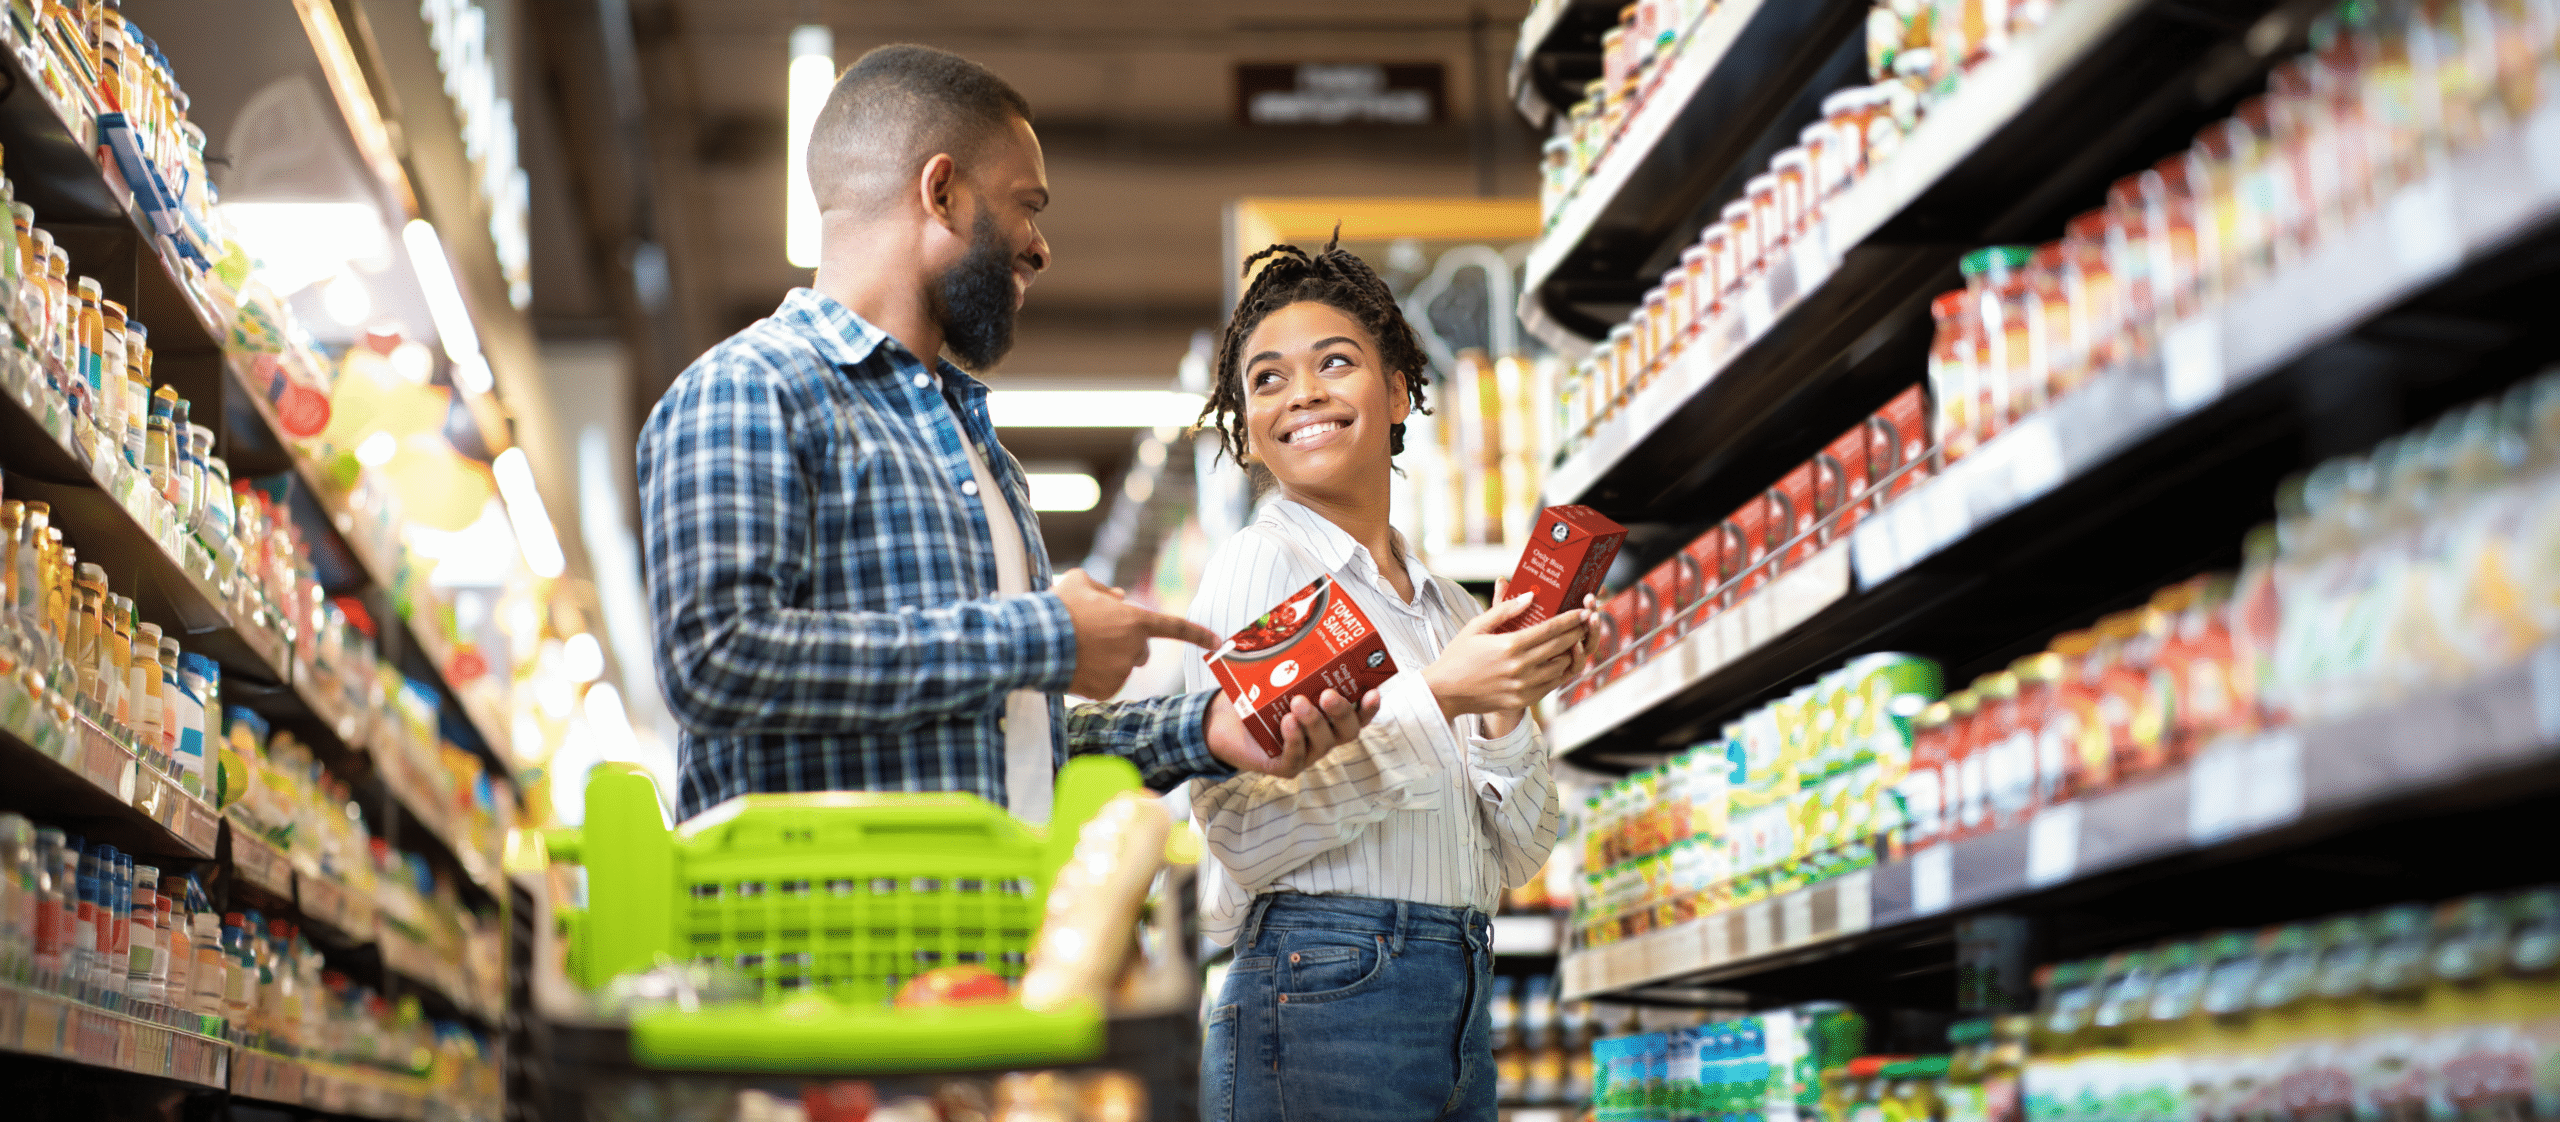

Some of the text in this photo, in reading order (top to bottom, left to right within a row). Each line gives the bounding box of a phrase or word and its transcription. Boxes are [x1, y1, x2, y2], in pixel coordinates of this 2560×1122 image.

[1533, 549, 1550, 563] Only
[1522, 561, 1539, 576] Love
[1546, 567, 1561, 579] and
[1330, 598, 1366, 637] TOMATO
[1322, 615, 1354, 648] SAUCE
[1321, 670, 1334, 687] Love
[1340, 663, 1351, 680] Only
